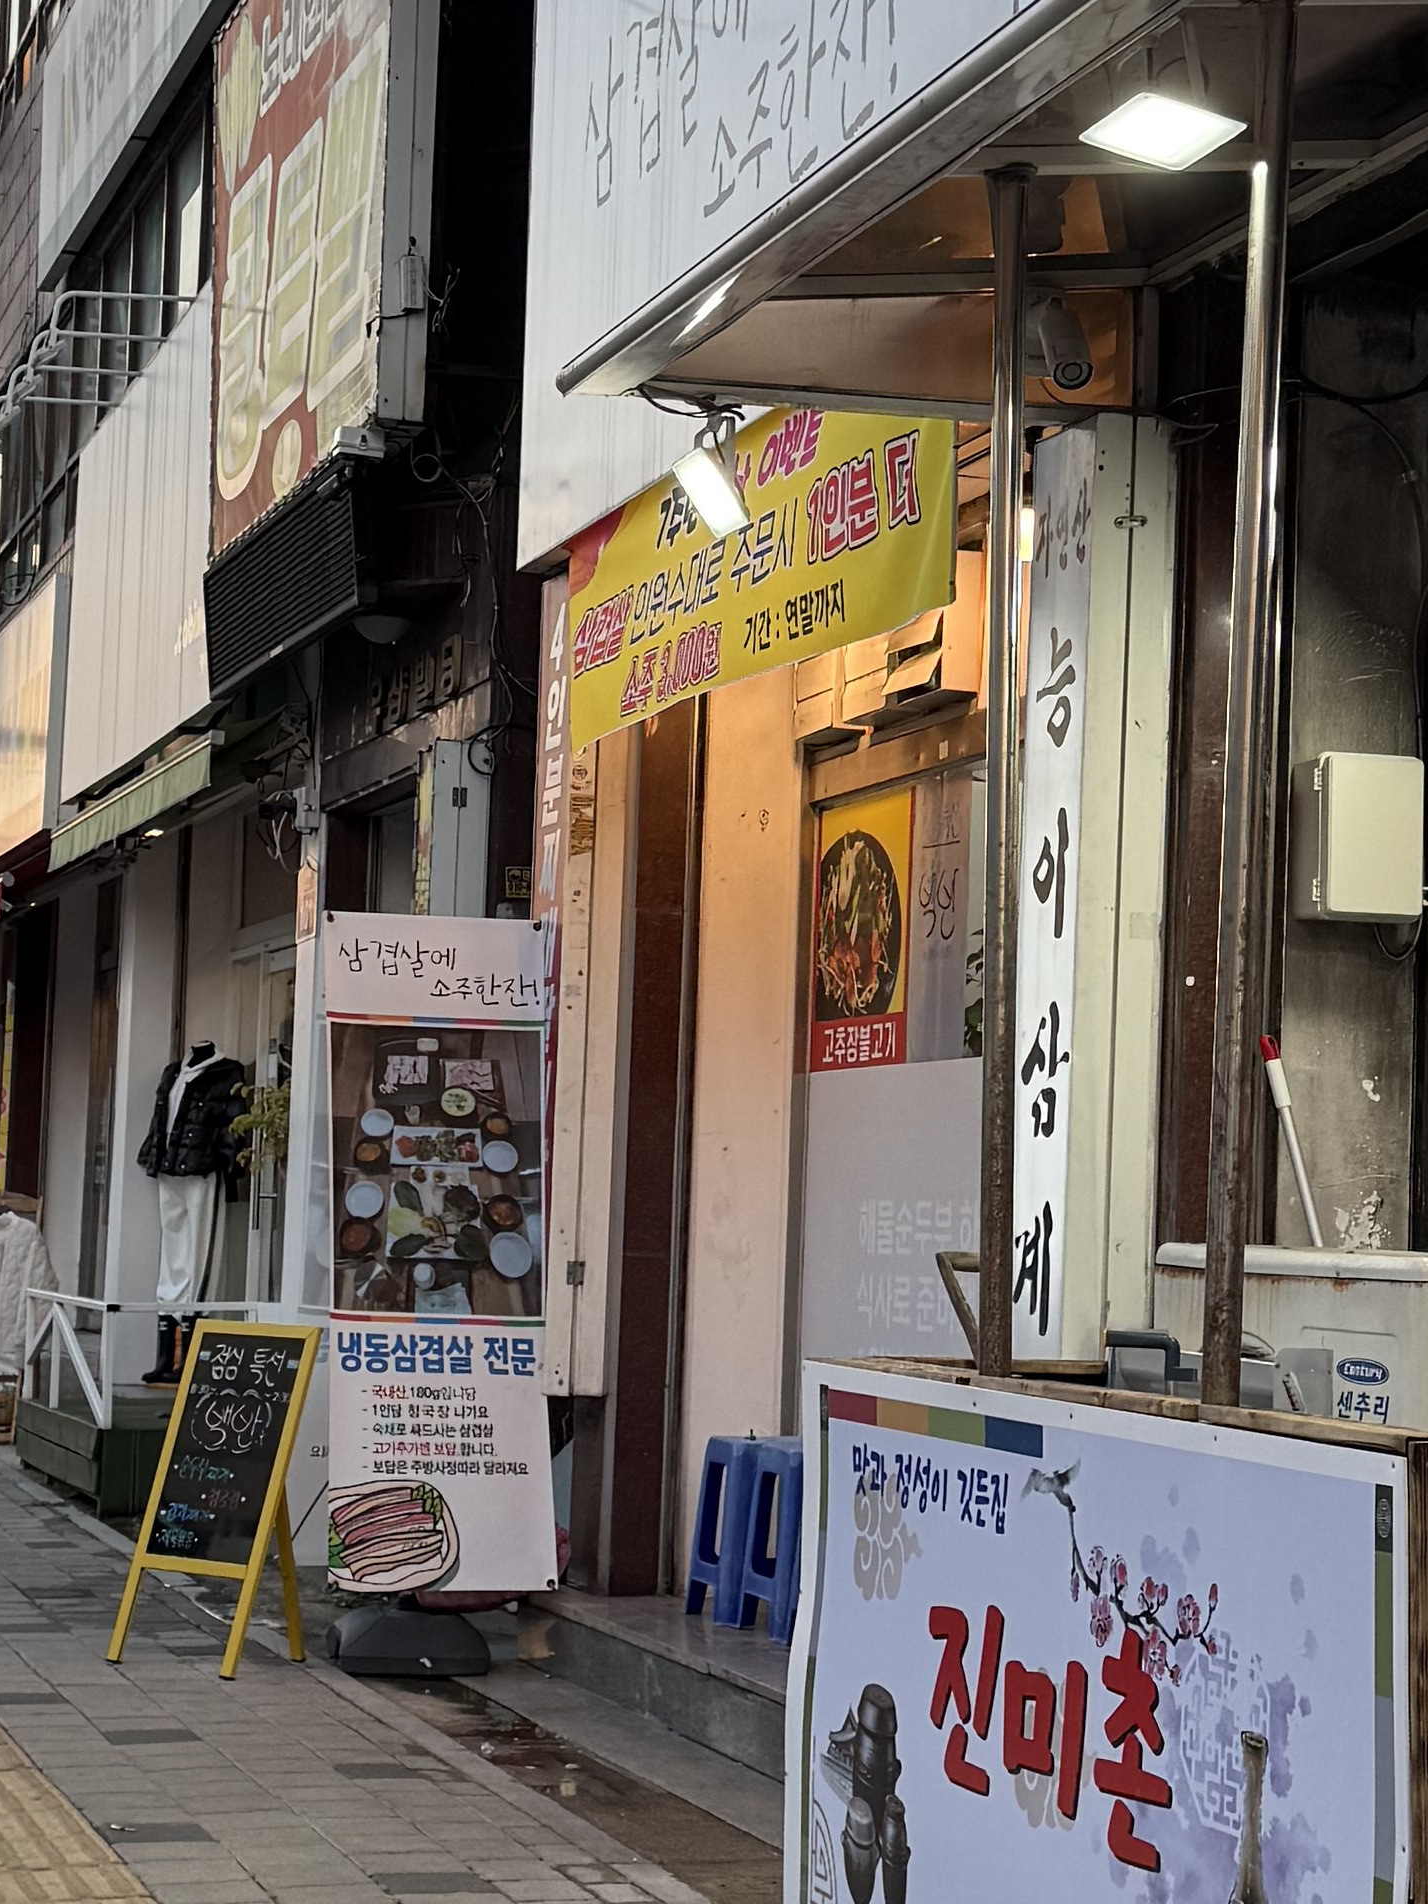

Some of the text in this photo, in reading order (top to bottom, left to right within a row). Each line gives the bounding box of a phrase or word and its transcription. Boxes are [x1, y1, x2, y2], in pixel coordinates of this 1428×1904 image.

[628, 532, 728, 647] 인원수대로
[730, 497, 799, 593] 주문시
[806, 448, 879, 565] 1인분
[885, 429, 920, 530] 더
[1036, 474, 1092, 586] 자연산
[742, 604, 772, 655] 기간
[784, 577, 846, 640] 연말까지
[338, 937, 458, 979] 삼겹살에
[429, 973, 541, 1008] 소주한잔!
[821, 1020, 897, 1065] 고추장불고기
[209, 1343, 246, 1381] 점심
[336, 1331, 537, 1377] 냉동삼겹살 전문
[371, 1384, 410, 1401] 국내산
[453, 1404, 490, 1420] 나가요
[1336, 1390, 1390, 1424] 센추리
[204, 1399, 264, 1448] 백반
[852, 1443, 1010, 1535] 맛과 정성이 깃든집
[928, 1602, 1173, 1874] 진미촌
